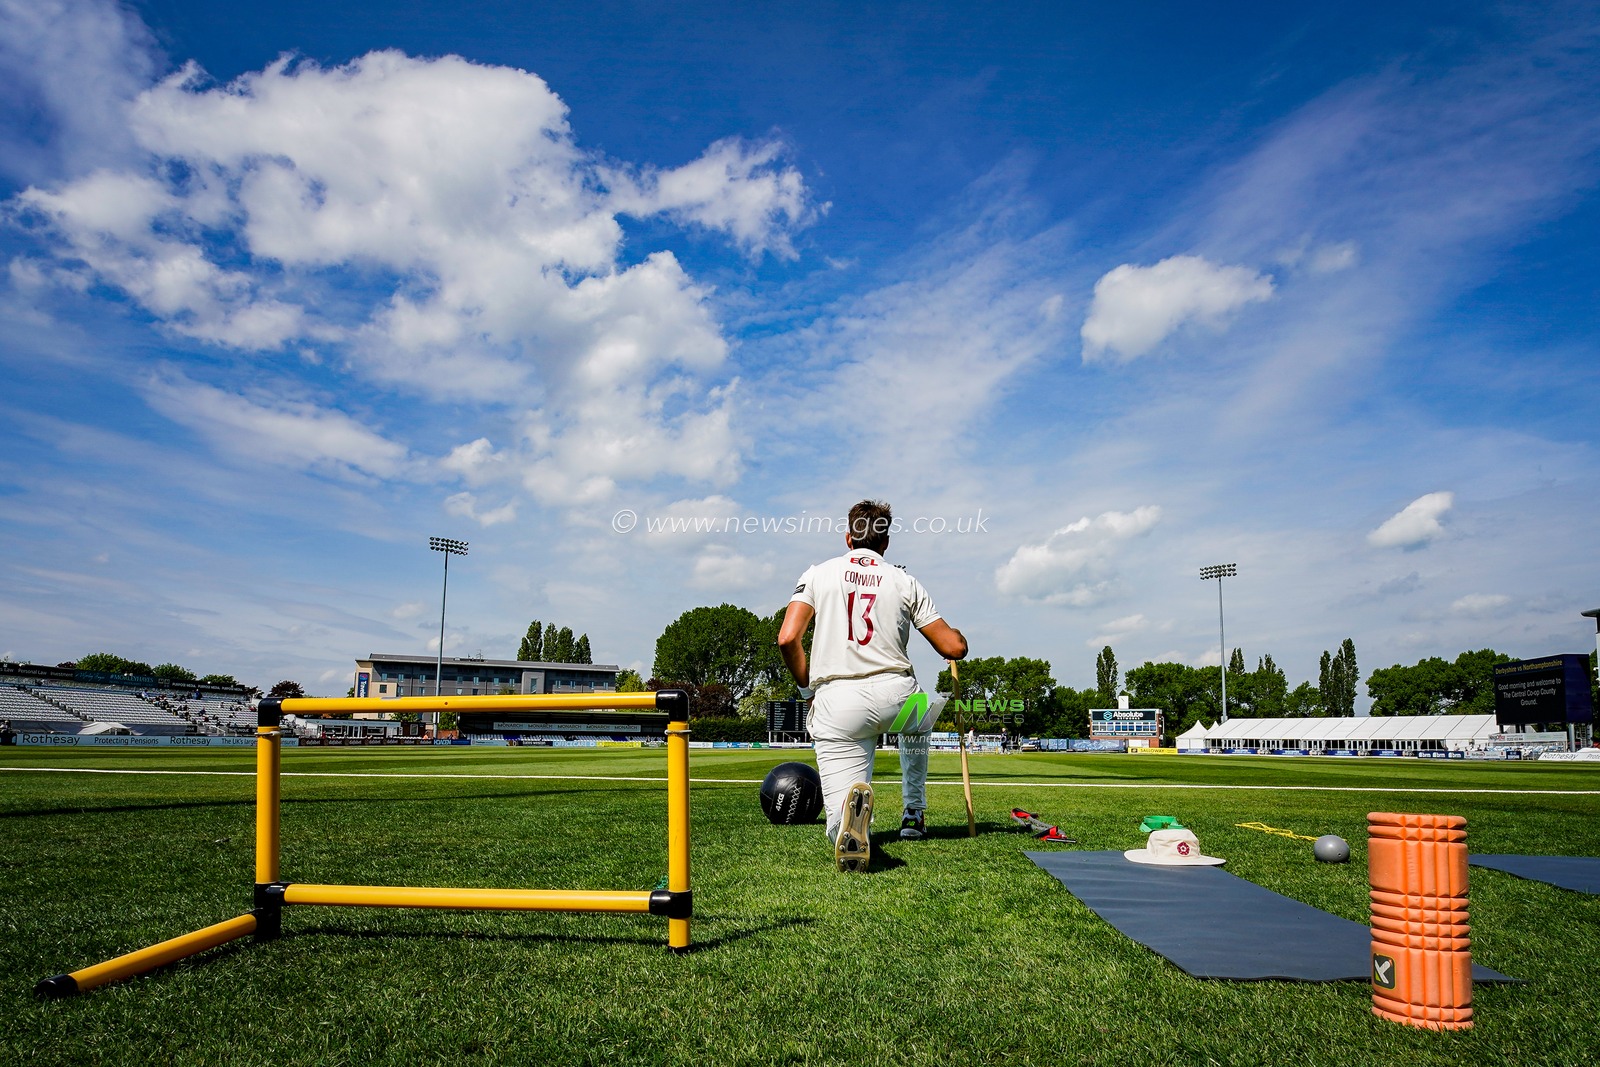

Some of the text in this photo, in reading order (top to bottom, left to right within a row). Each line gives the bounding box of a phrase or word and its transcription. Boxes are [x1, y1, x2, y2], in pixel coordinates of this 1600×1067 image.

[844, 570, 884, 587] CONWAY
[847, 591, 877, 646] 13
[1498, 683, 1509, 691] Good
[22, 733, 81, 746] Rothesay
[94, 737, 159, 746] Protecting Pensions
[169, 736, 212, 746] Rothesay
[775, 792, 785, 812] 4KG
